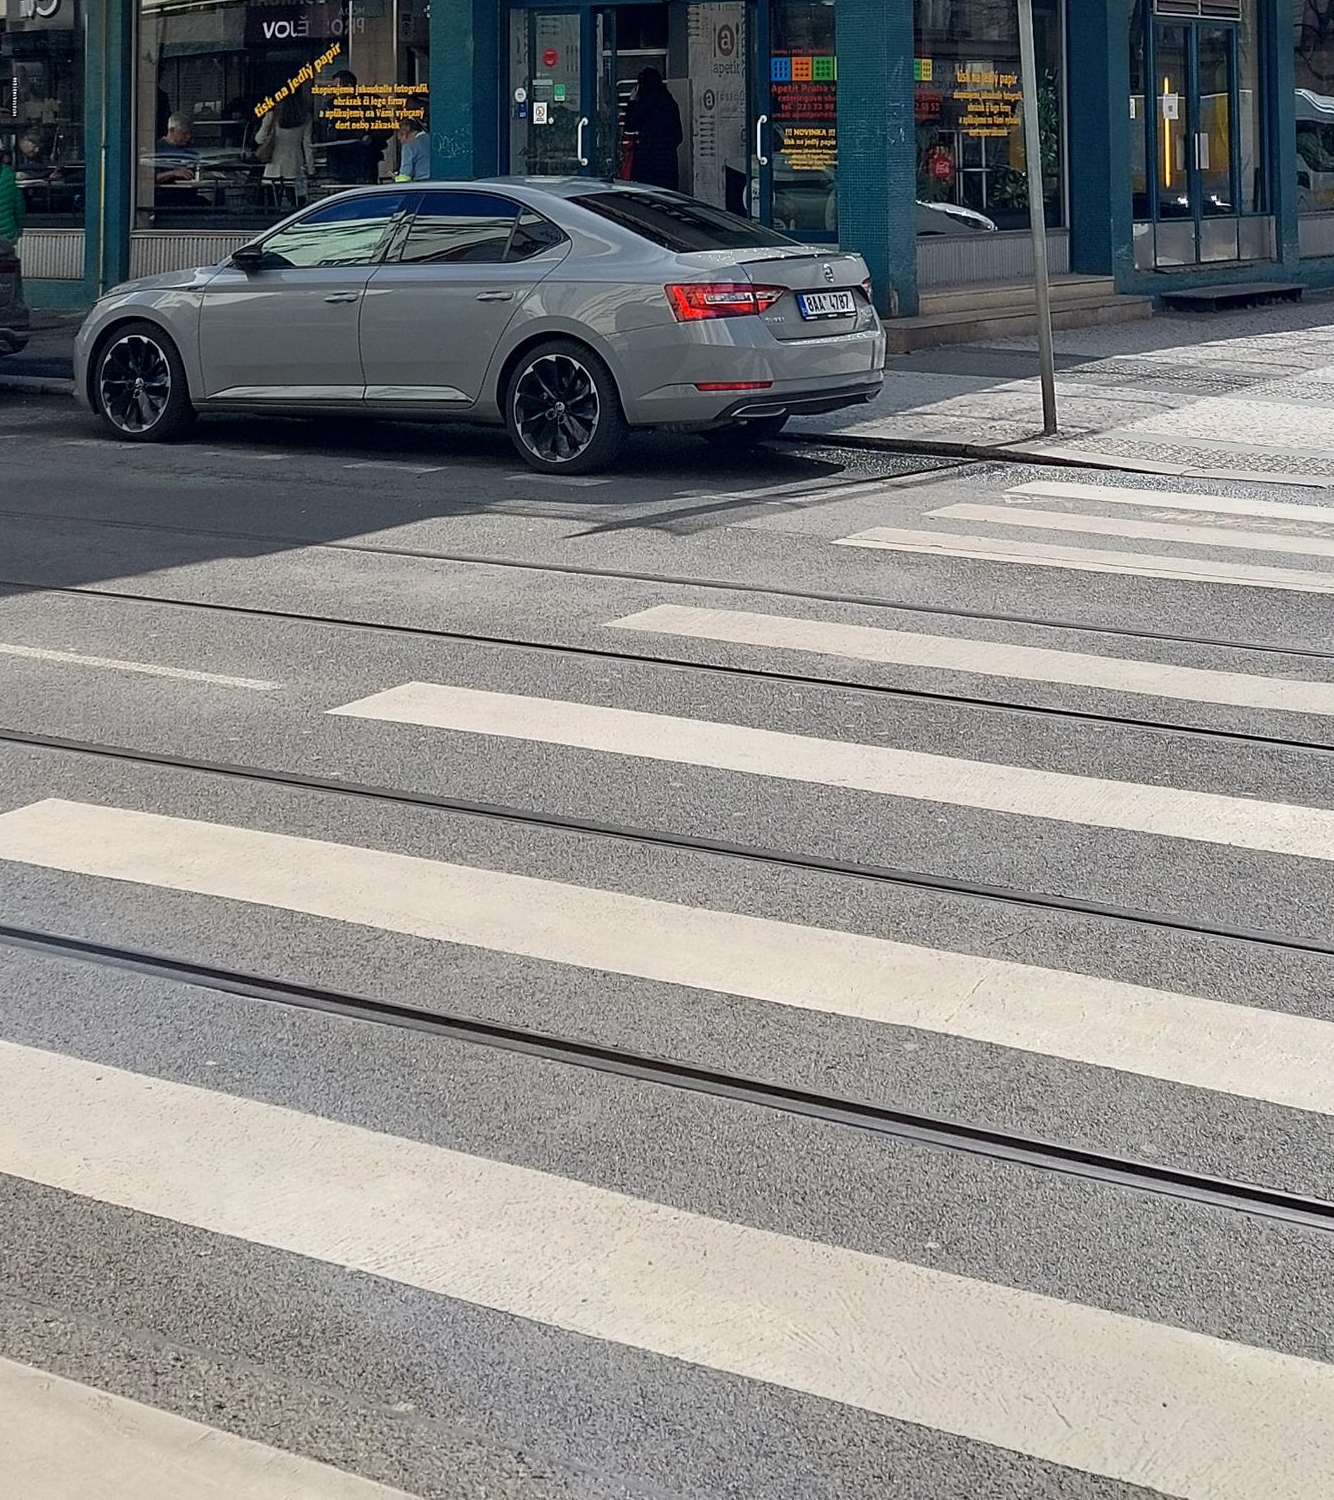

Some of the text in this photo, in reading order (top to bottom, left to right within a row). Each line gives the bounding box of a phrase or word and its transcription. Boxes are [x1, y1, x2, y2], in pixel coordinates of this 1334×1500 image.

[254, 41, 341, 118] tisk na jedlý papír
[713, 60, 740, 78] apetit
